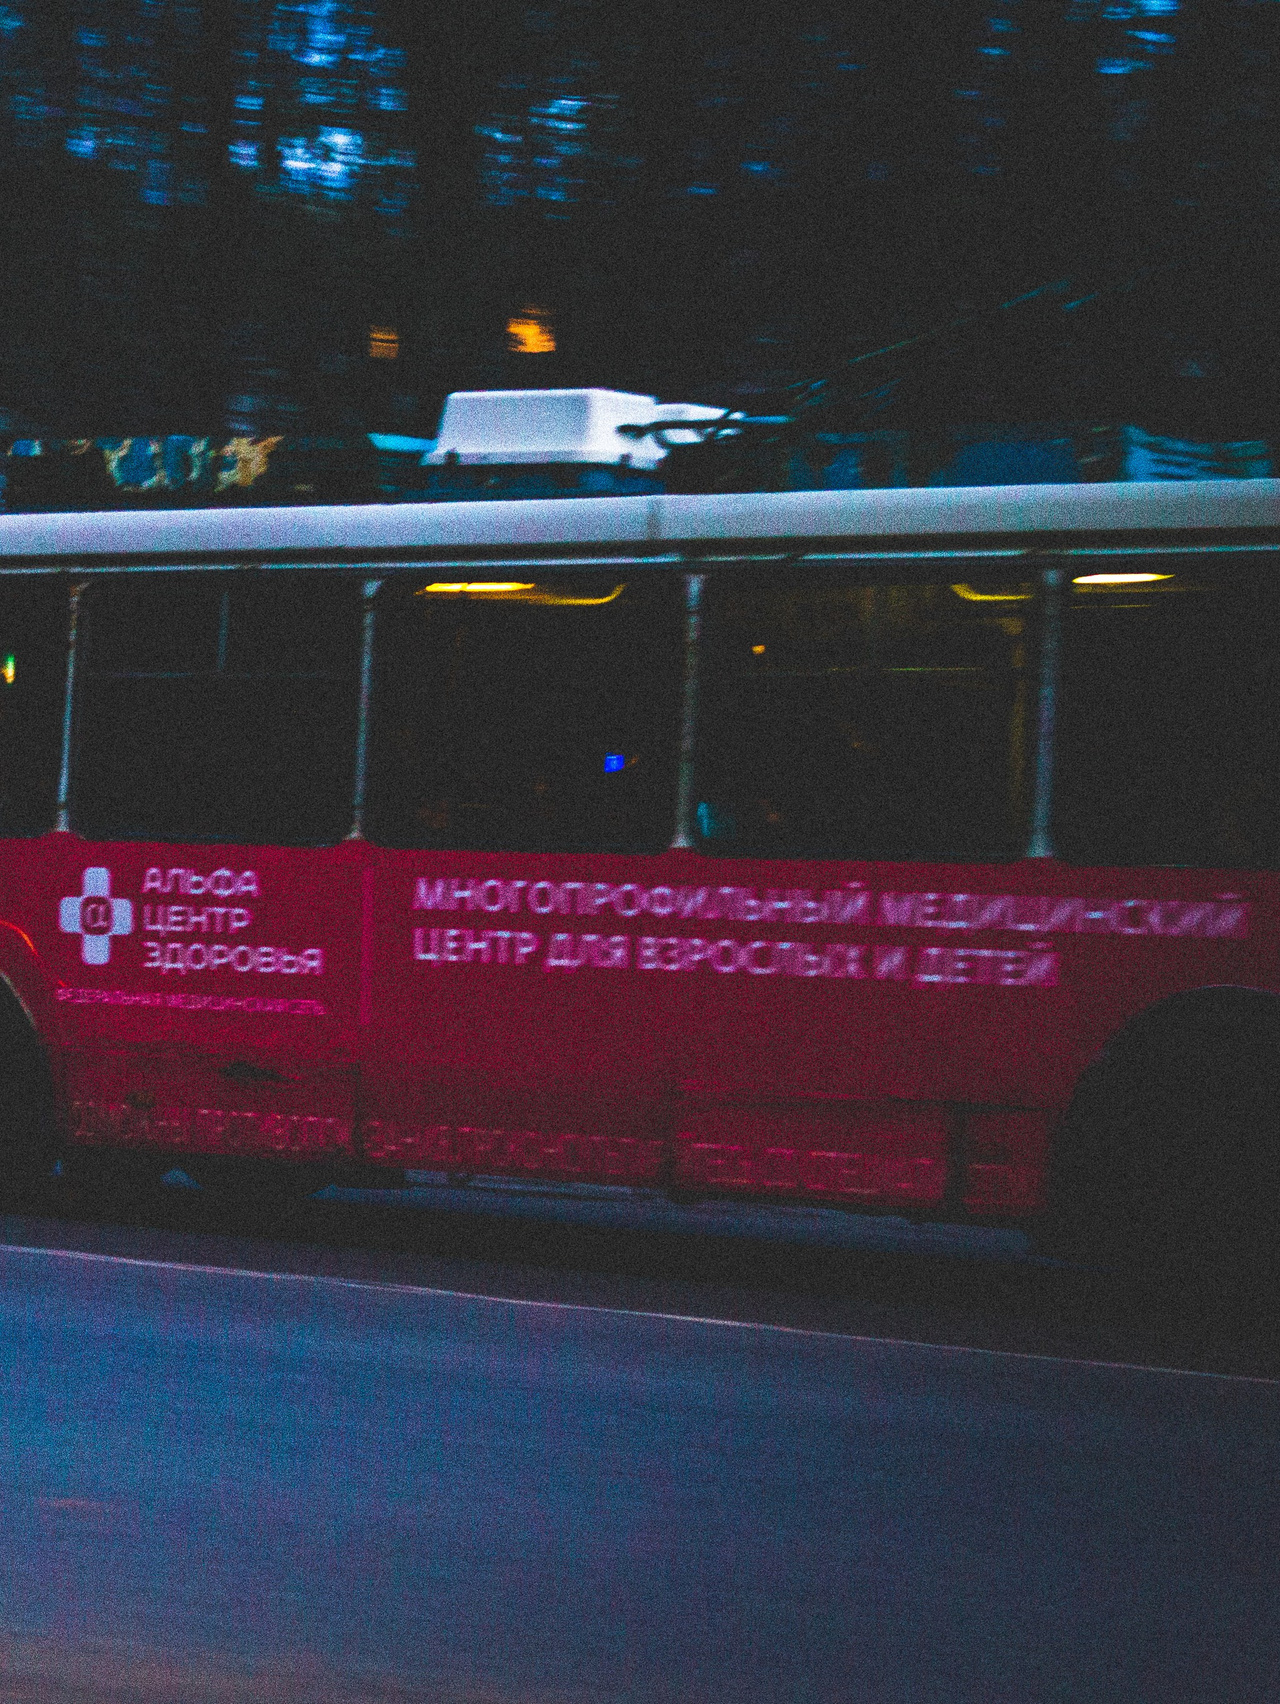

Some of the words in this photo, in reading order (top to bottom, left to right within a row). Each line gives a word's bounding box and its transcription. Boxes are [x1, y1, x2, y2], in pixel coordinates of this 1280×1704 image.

[142, 866, 260, 897] АЛЬФА
[142, 903, 252, 938] ЦЕНТР
[412, 876, 869, 926] МНОГОПРОФИЛЬНЫЙ
[878, 890, 1249, 938] МЕДИЦИНСКИЙ
[142, 940, 324, 976] ЗДОРОВЬЯ
[413, 927, 538, 968] ЦЕНТР
[542, 932, 631, 973] ДЛЯ
[635, 936, 869, 980] ВЗРОСЛЫХ
[873, 944, 912, 980] И
[910, 941, 1061, 989] ДЕТЕЙ
